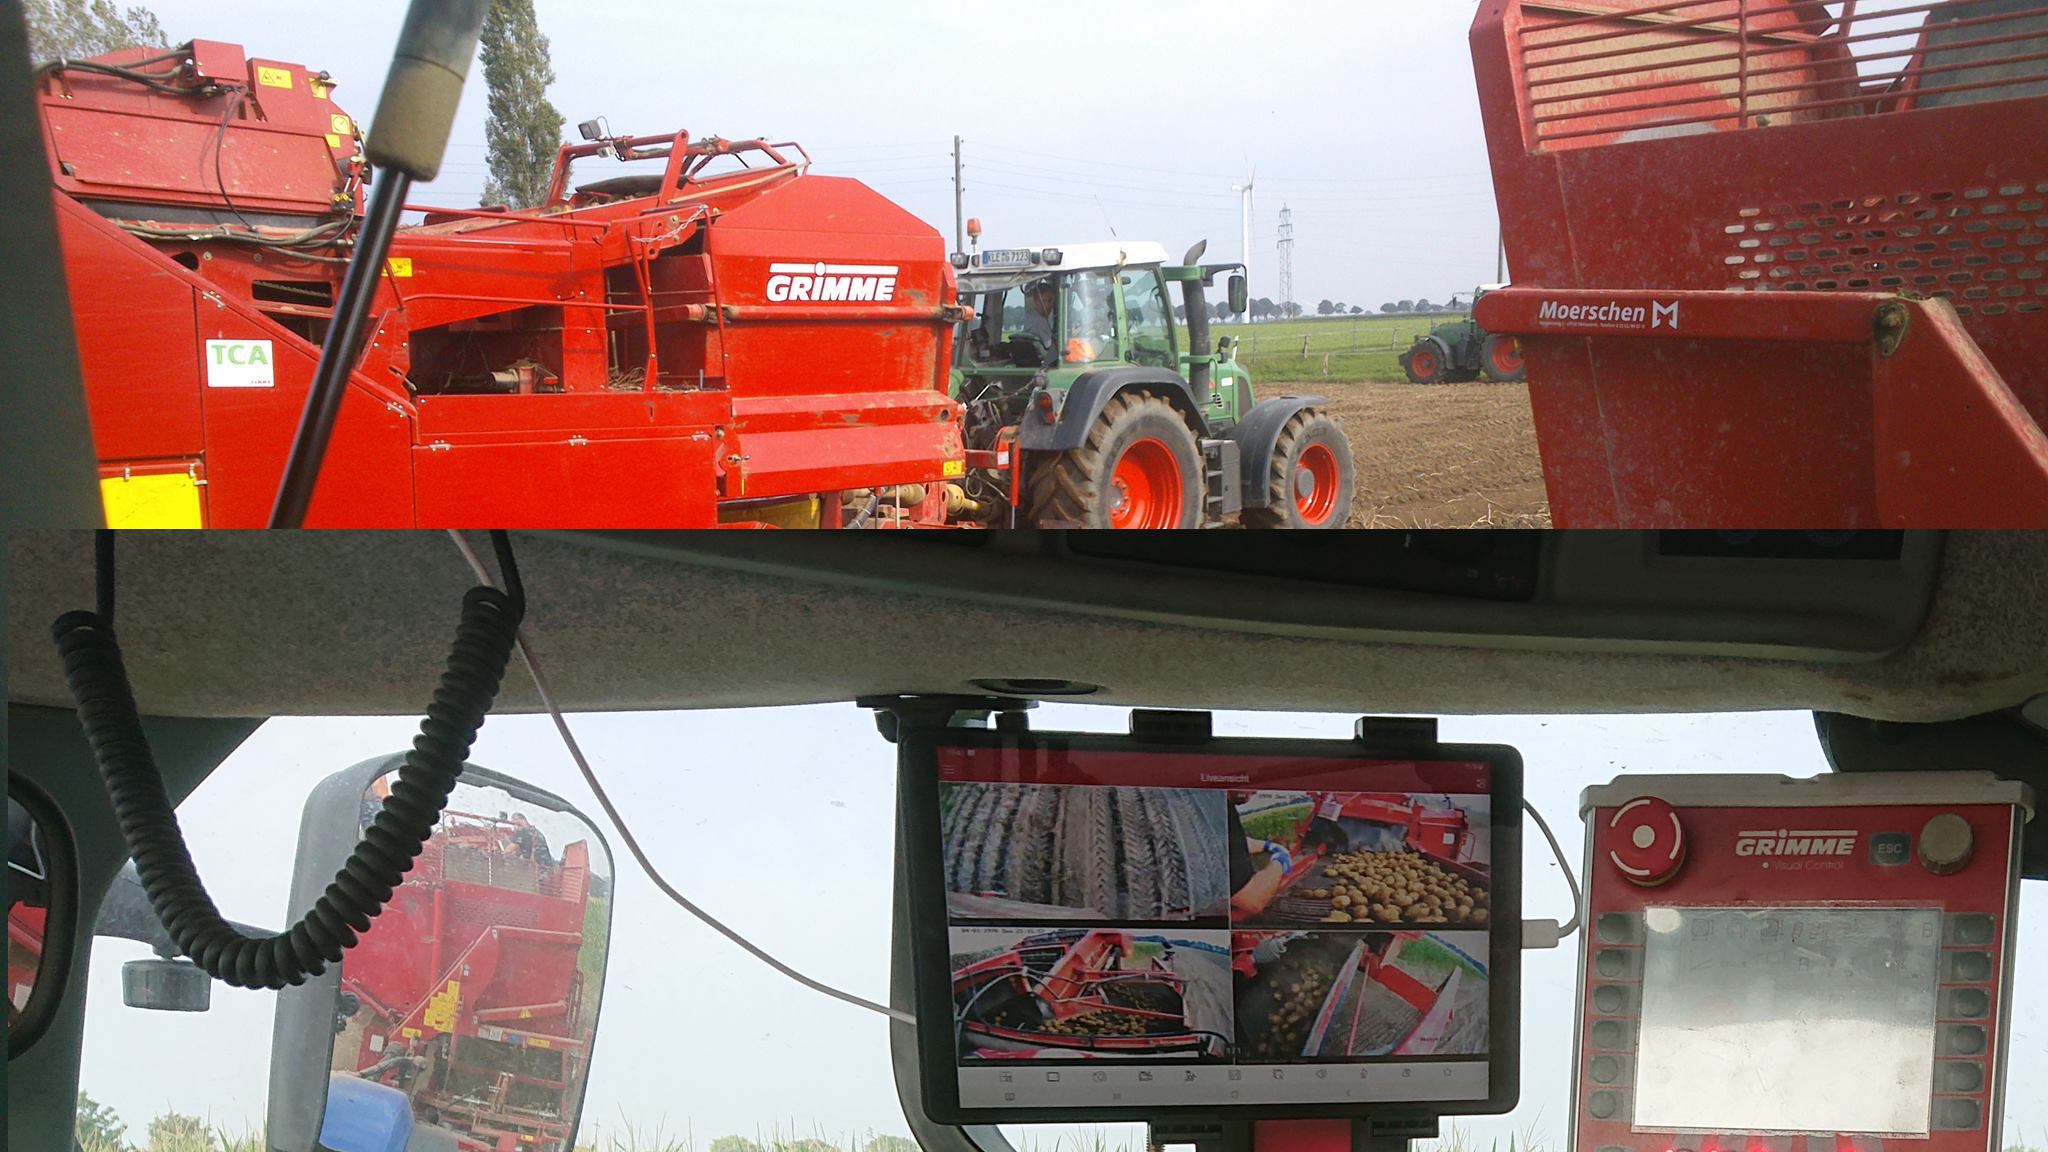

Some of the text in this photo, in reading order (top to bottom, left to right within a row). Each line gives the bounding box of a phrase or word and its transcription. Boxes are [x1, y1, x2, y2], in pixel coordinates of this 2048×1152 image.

[766, 262, 898, 302] GRIMME
[1539, 301, 1645, 322] Moerschen
[211, 345, 268, 365] TCA
[1735, 828, 1858, 857] GRIMME
[1878, 843, 1902, 854] ESC
[1773, 860, 1844, 871] Visual Control
